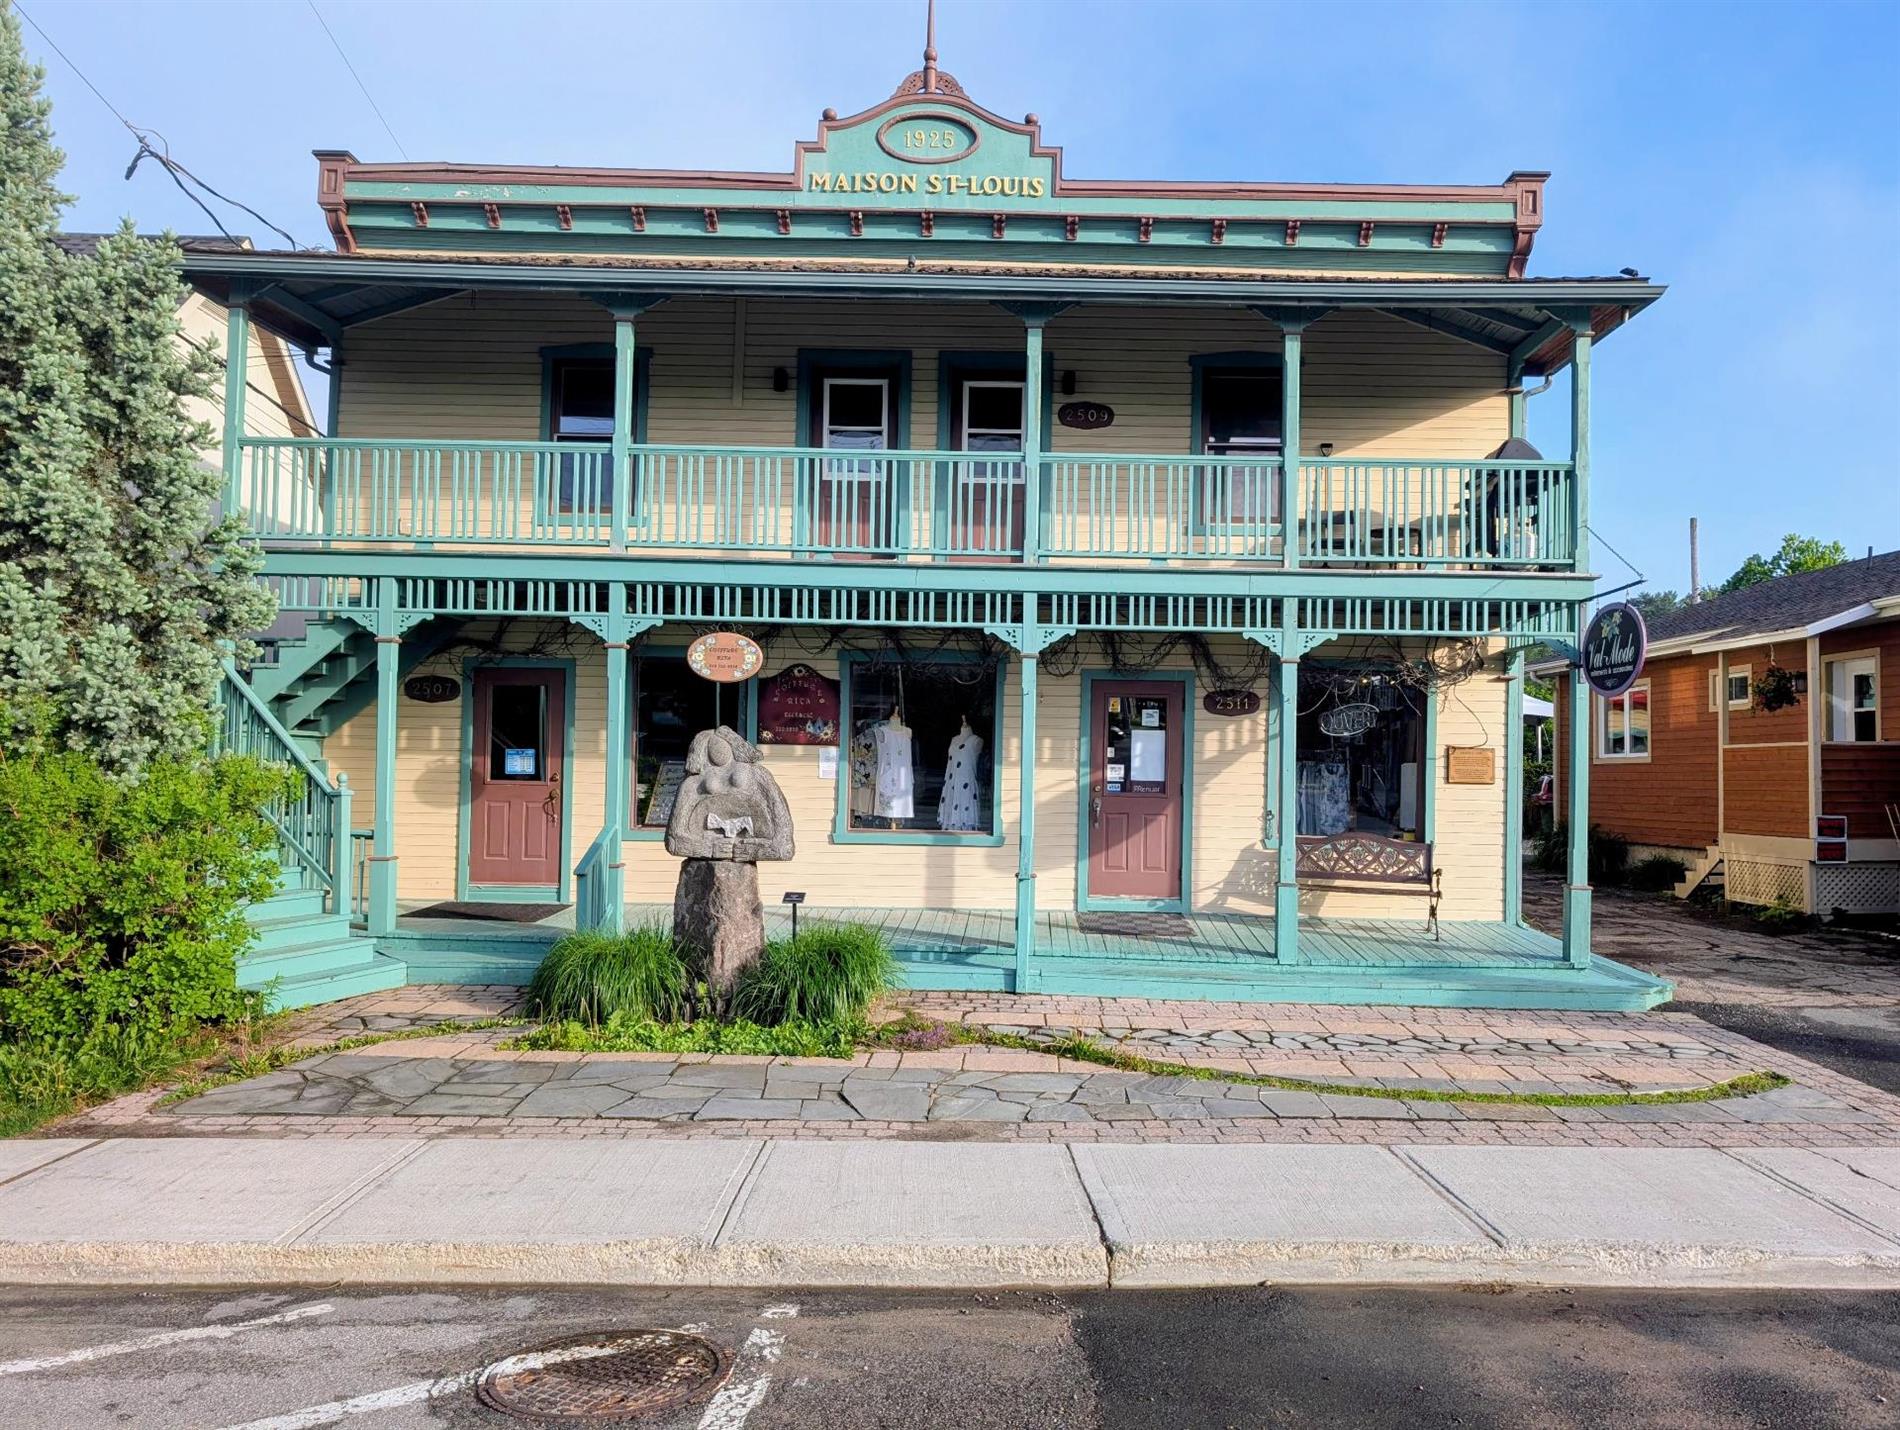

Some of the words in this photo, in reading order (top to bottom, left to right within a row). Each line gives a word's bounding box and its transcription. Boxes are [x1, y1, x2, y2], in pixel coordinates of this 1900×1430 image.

[903, 130, 955, 149] 1925
[810, 171, 918, 193] MAISON
[925, 174, 1045, 197] ST-LOUIS
[1065, 409, 1109, 421] 2509
[1588, 638, 1606, 669] Val
[1605, 633, 1635, 664] Mode
[412, 682, 452, 697] 2507
[1215, 696, 1249, 710] 2511
[1320, 709, 1378, 731] OUVERT
